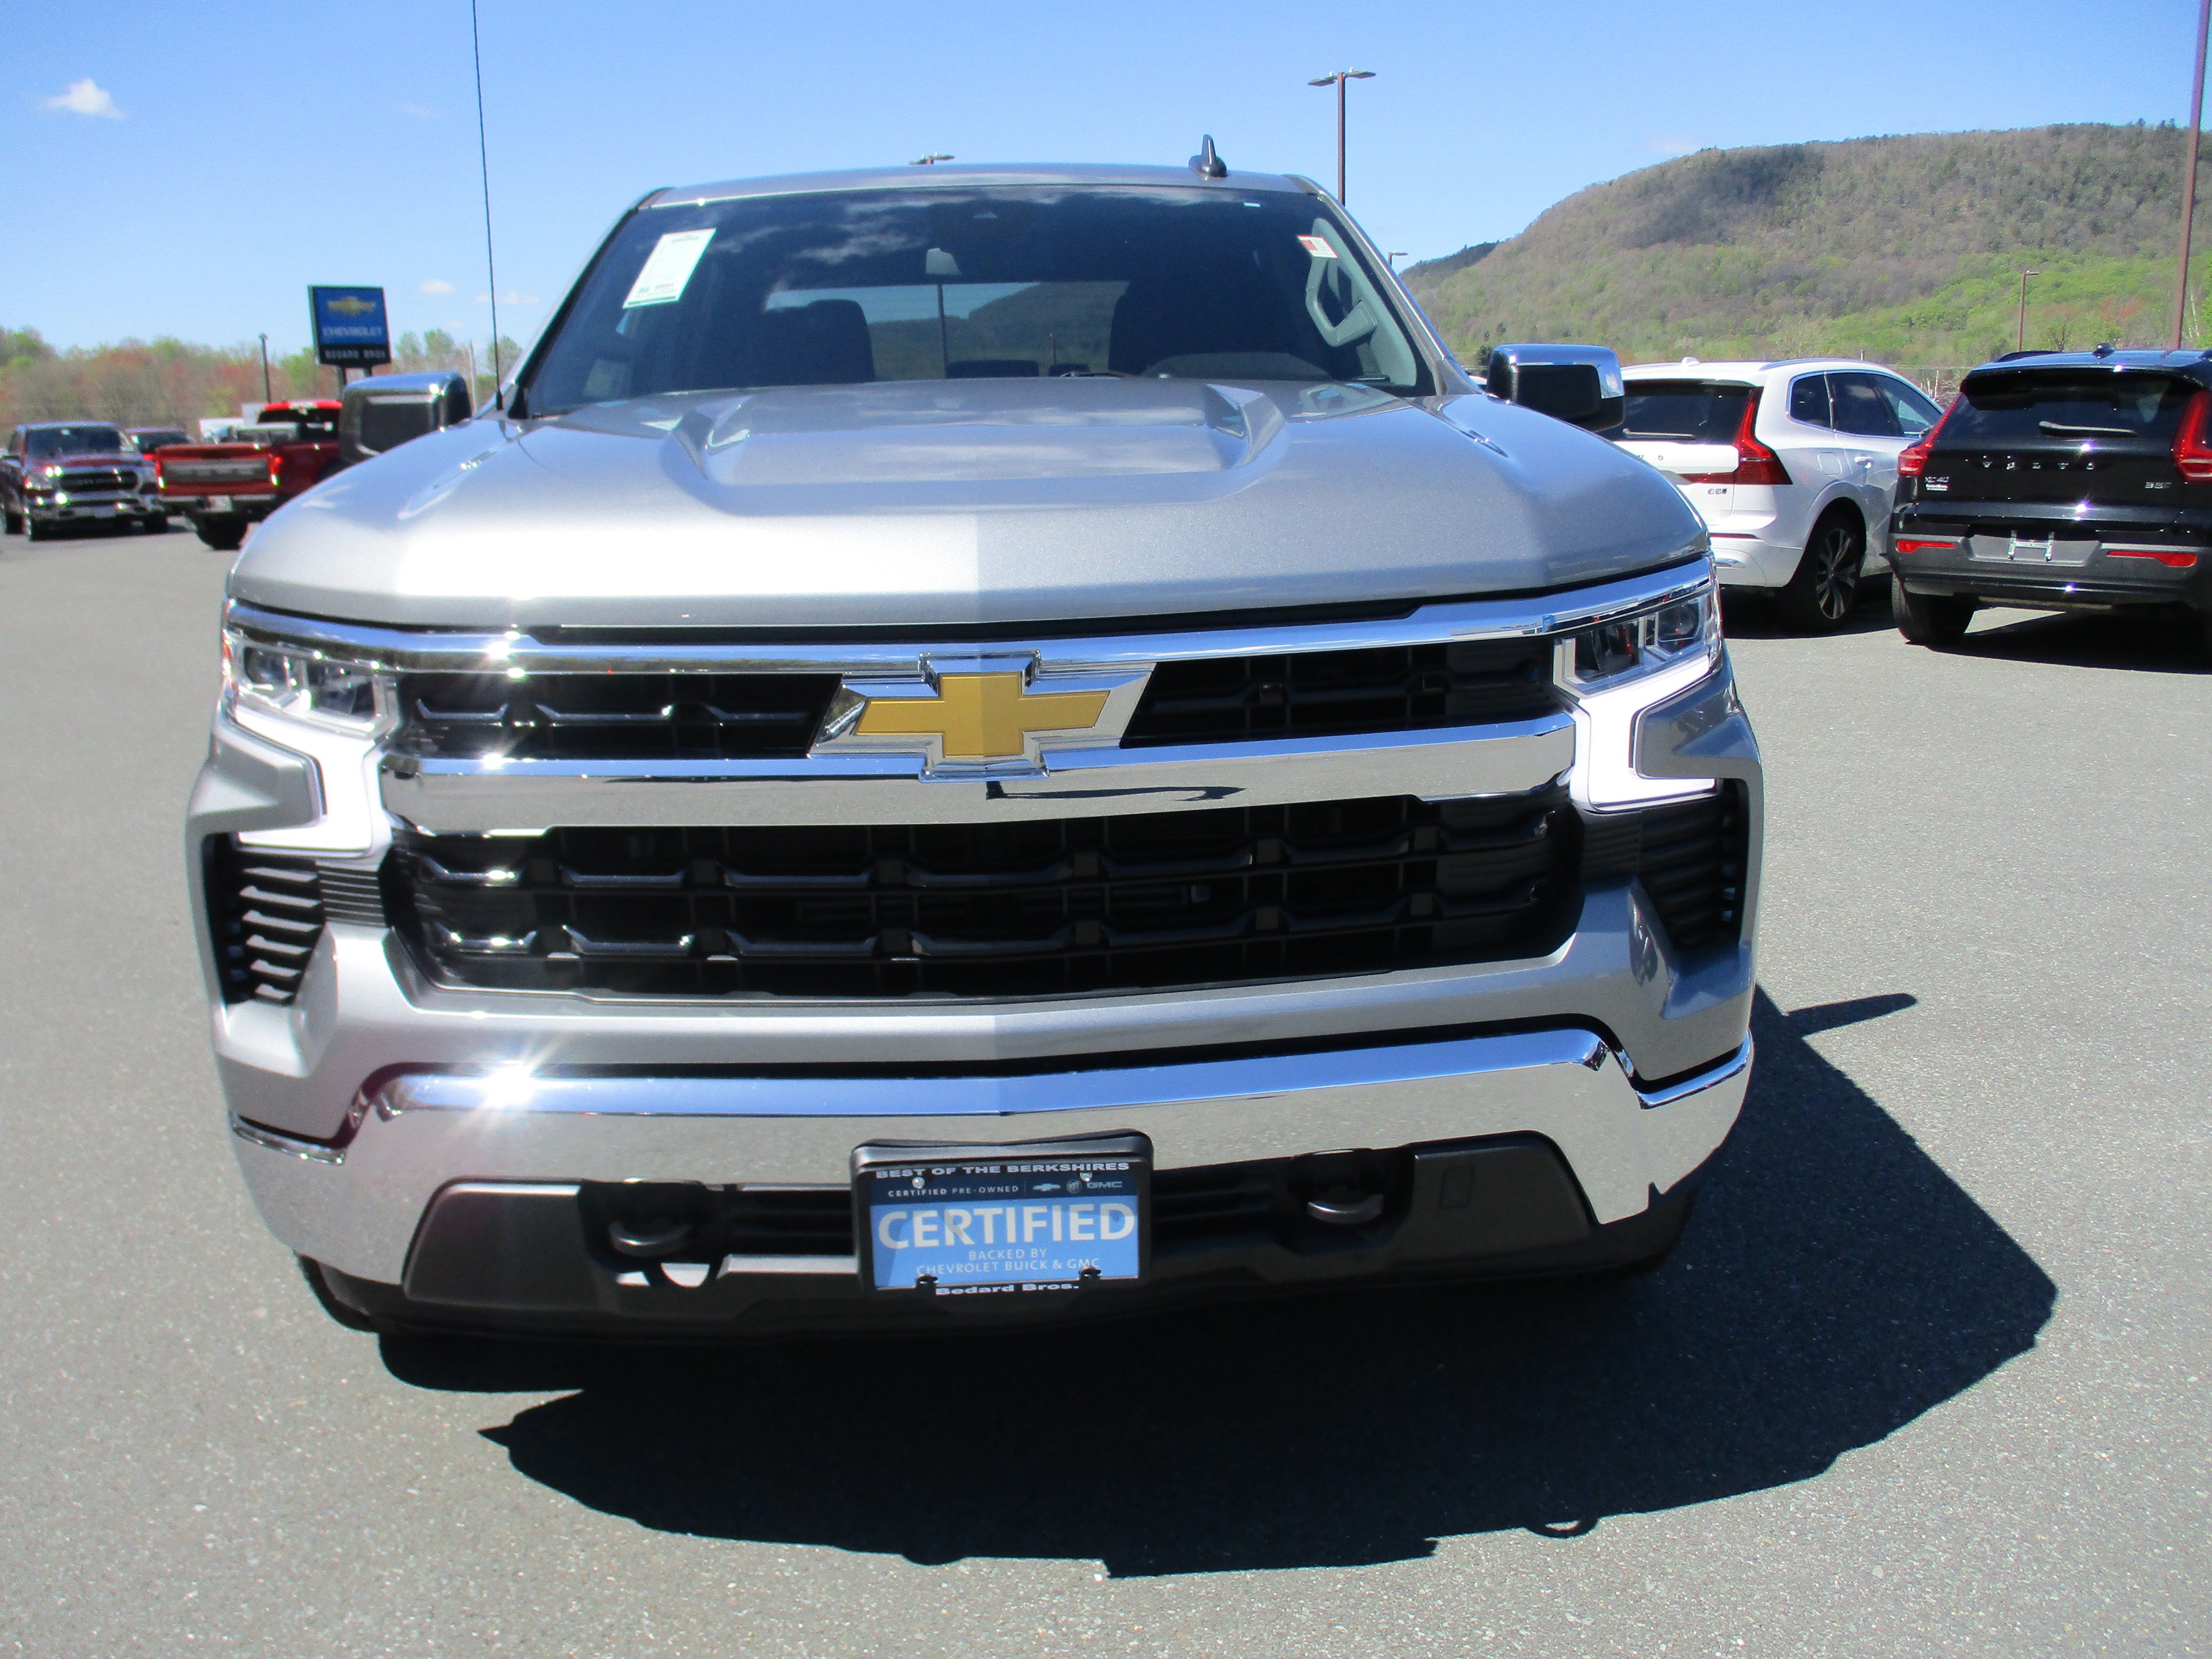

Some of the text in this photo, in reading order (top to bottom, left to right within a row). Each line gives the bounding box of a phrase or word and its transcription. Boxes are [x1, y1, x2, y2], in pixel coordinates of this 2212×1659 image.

[876, 1162, 1130, 1179] BEST OF THE BERKSHIRES
[888, 1188, 947, 1197] CERTIFIED
[952, 1185, 1019, 1194] PRE-OWNED
[878, 1203, 1135, 1249] CERTIFIED
[969, 1248, 1047, 1261] BACKED BY
[917, 1258, 1100, 1276] CHEVROLET BUICK & GMC
[935, 1282, 1079, 1296] Bedard Bros.
